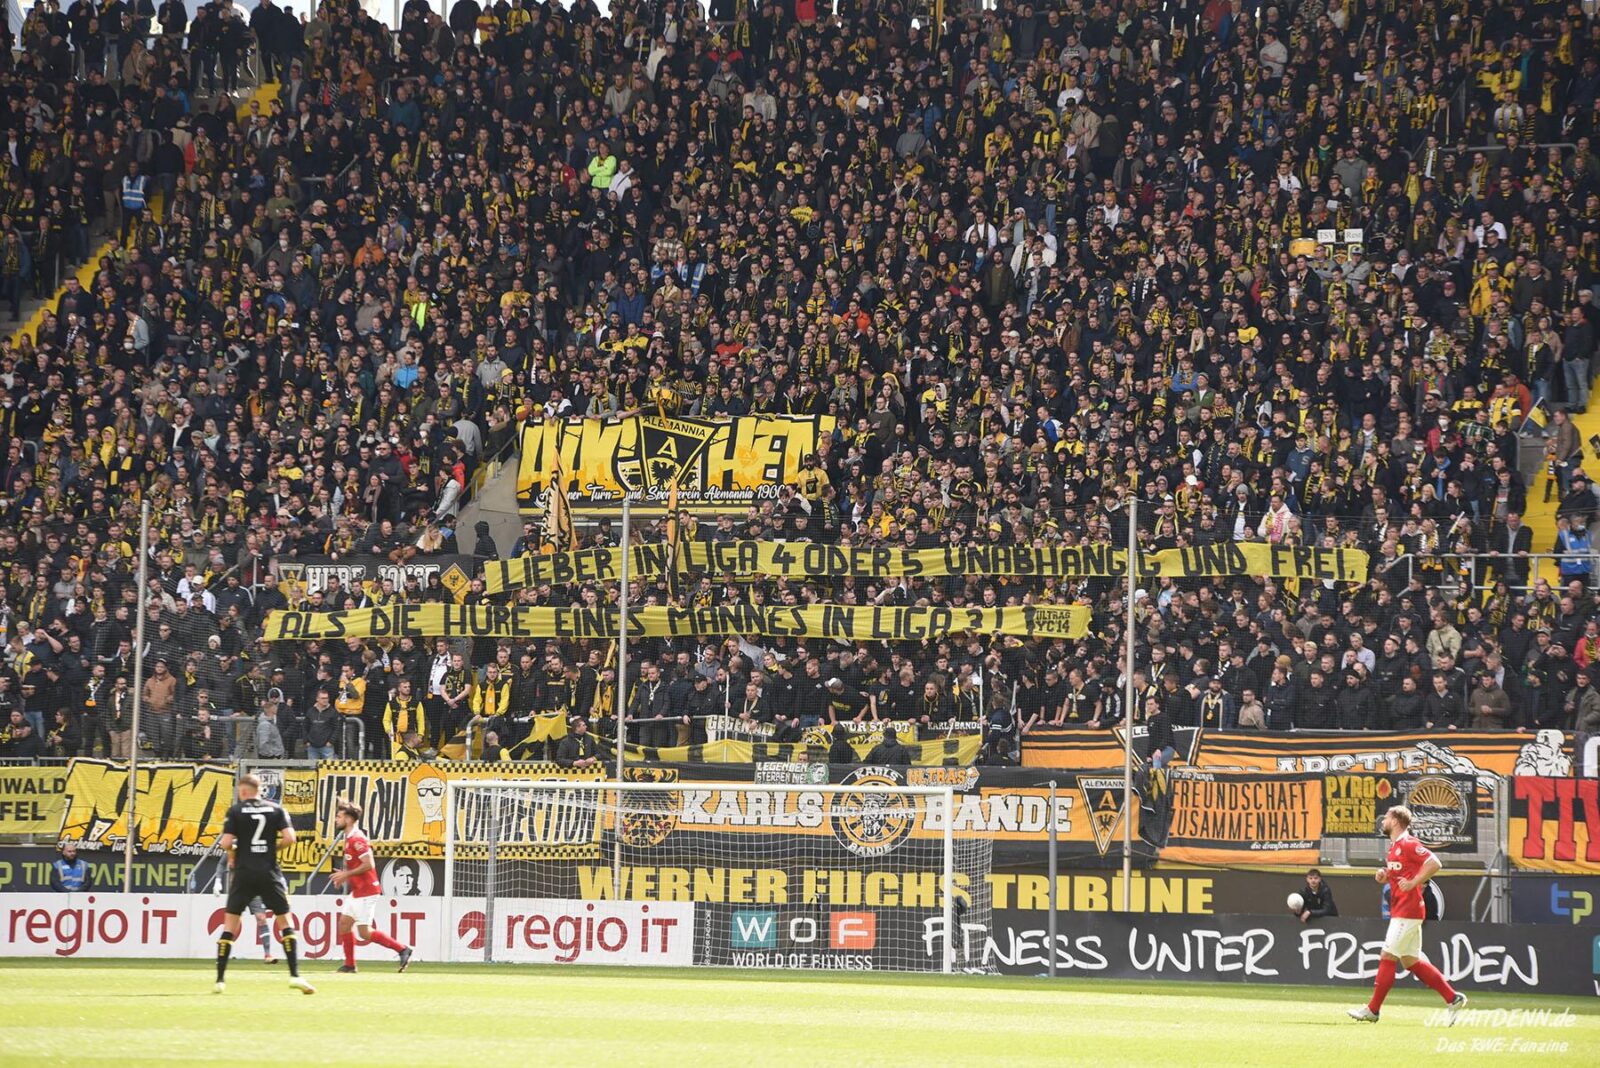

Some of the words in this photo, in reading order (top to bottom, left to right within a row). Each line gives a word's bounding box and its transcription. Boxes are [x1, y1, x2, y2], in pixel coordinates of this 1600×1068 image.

[501, 548, 615, 590] LIEBER
[634, 544, 669, 576] IN
[683, 540, 758, 573] LIGA
[771, 543, 796, 574] 4
[803, 543, 892, 576] ODER
[902, 547, 923, 576] 5
[944, 544, 1161, 577] UNABHANGG
[1180, 542, 1247, 577] UND
[278, 610, 348, 639] ALS
[370, 604, 424, 637] DIE
[444, 604, 531, 636] HURE
[554, 606, 646, 638] EINES
[667, 604, 809, 636] MANNES
[822, 605, 855, 638] IN
[872, 606, 953, 639] LIGA
[1036, 610, 1071, 620] ULTRAS
[755, 761, 809, 773] LEGENDEN
[855, 767, 899, 782] KARLS
[907, 768, 967, 786] ULTRAS
[0, 777, 67, 795] WALD
[1172, 780, 1308, 812] FREUNDSCHAFT
[1325, 775, 1376, 799] PYRO
[680, 789, 824, 829] KARLS
[923, 794, 1074, 833] BANDE
[1326, 805, 1376, 822] KEIN
[250, 813, 268, 846] 2
[1411, 826, 1454, 839] TIVOLI
[577, 865, 789, 904] WERNER
[802, 869, 972, 909] FUCHS
[984, 868, 1214, 915] TRIBÜNE
[8, 895, 129, 957] regio
[506, 903, 628, 963] regio
[732, 952, 785, 968] WORLD
[788, 953, 807, 969] OF
[812, 954, 873, 970] FITNESS
[921, 917, 1109, 971] FTNESS
[1128, 927, 1280, 976] UNTER
[1298, 928, 1540, 987] FRENDEN
